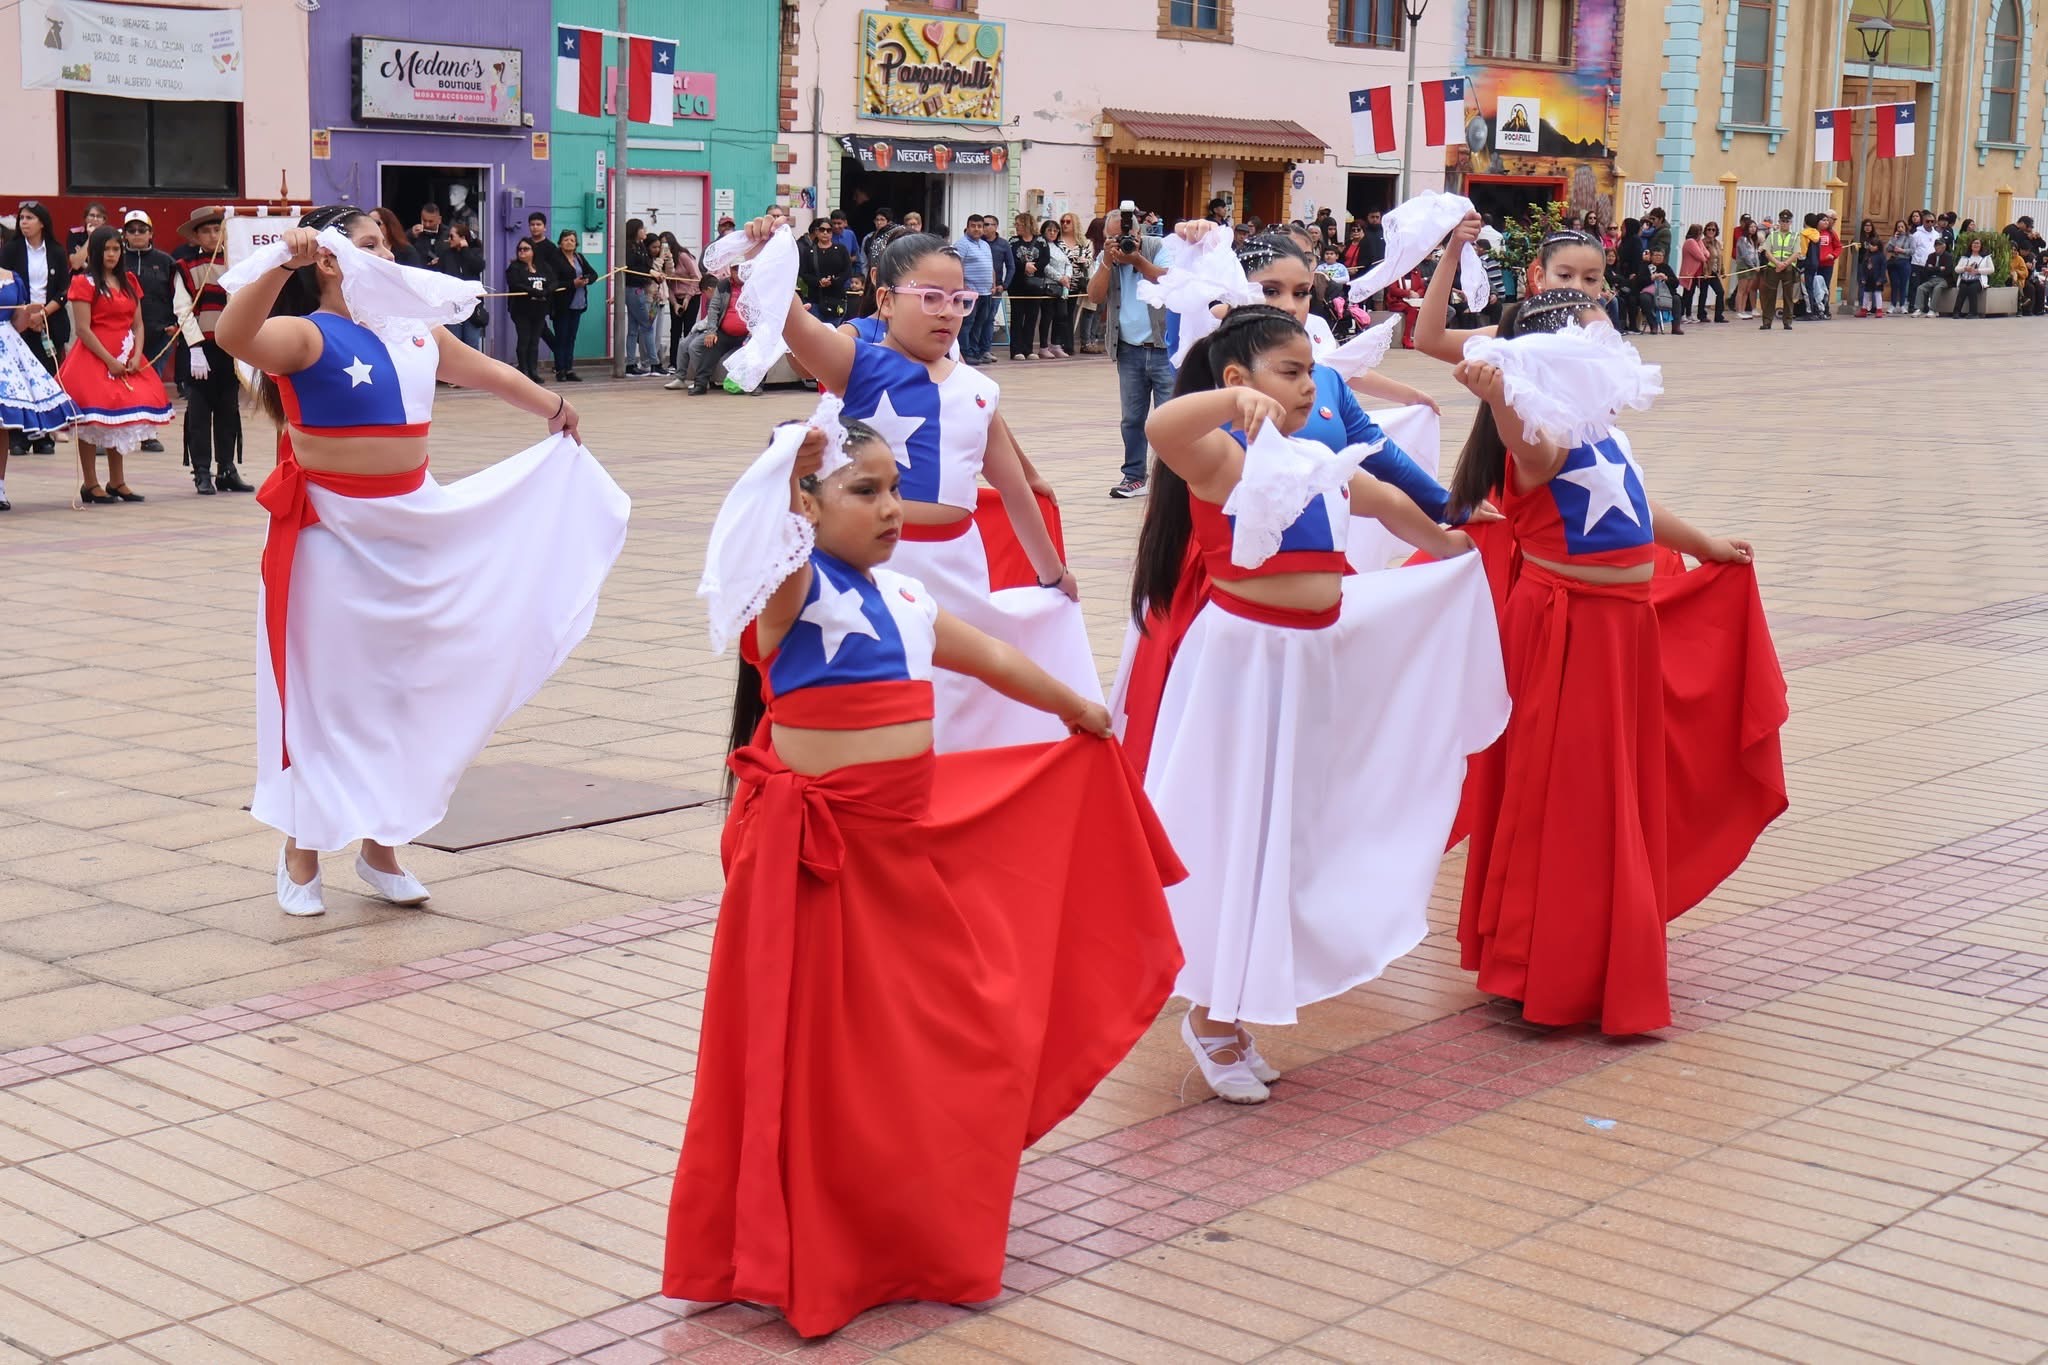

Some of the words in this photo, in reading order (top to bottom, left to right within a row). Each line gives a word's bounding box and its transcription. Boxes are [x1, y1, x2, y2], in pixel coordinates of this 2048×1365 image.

[82, 32, 103, 43] HASTA
[110, 35, 123, 46] QUE
[130, 37, 139, 47] SE
[128, 54, 137, 64] DE
[381, 48, 485, 88] Medano's
[107, 74, 121, 85] SAN
[124, 75, 151, 88] ALBERTO
[155, 79, 183, 91] HURTADO
[438, 80, 482, 91] BOUTIQUE
[441, 92, 485, 102] ACCESORIOS
[252, 234, 284, 246] ESC
